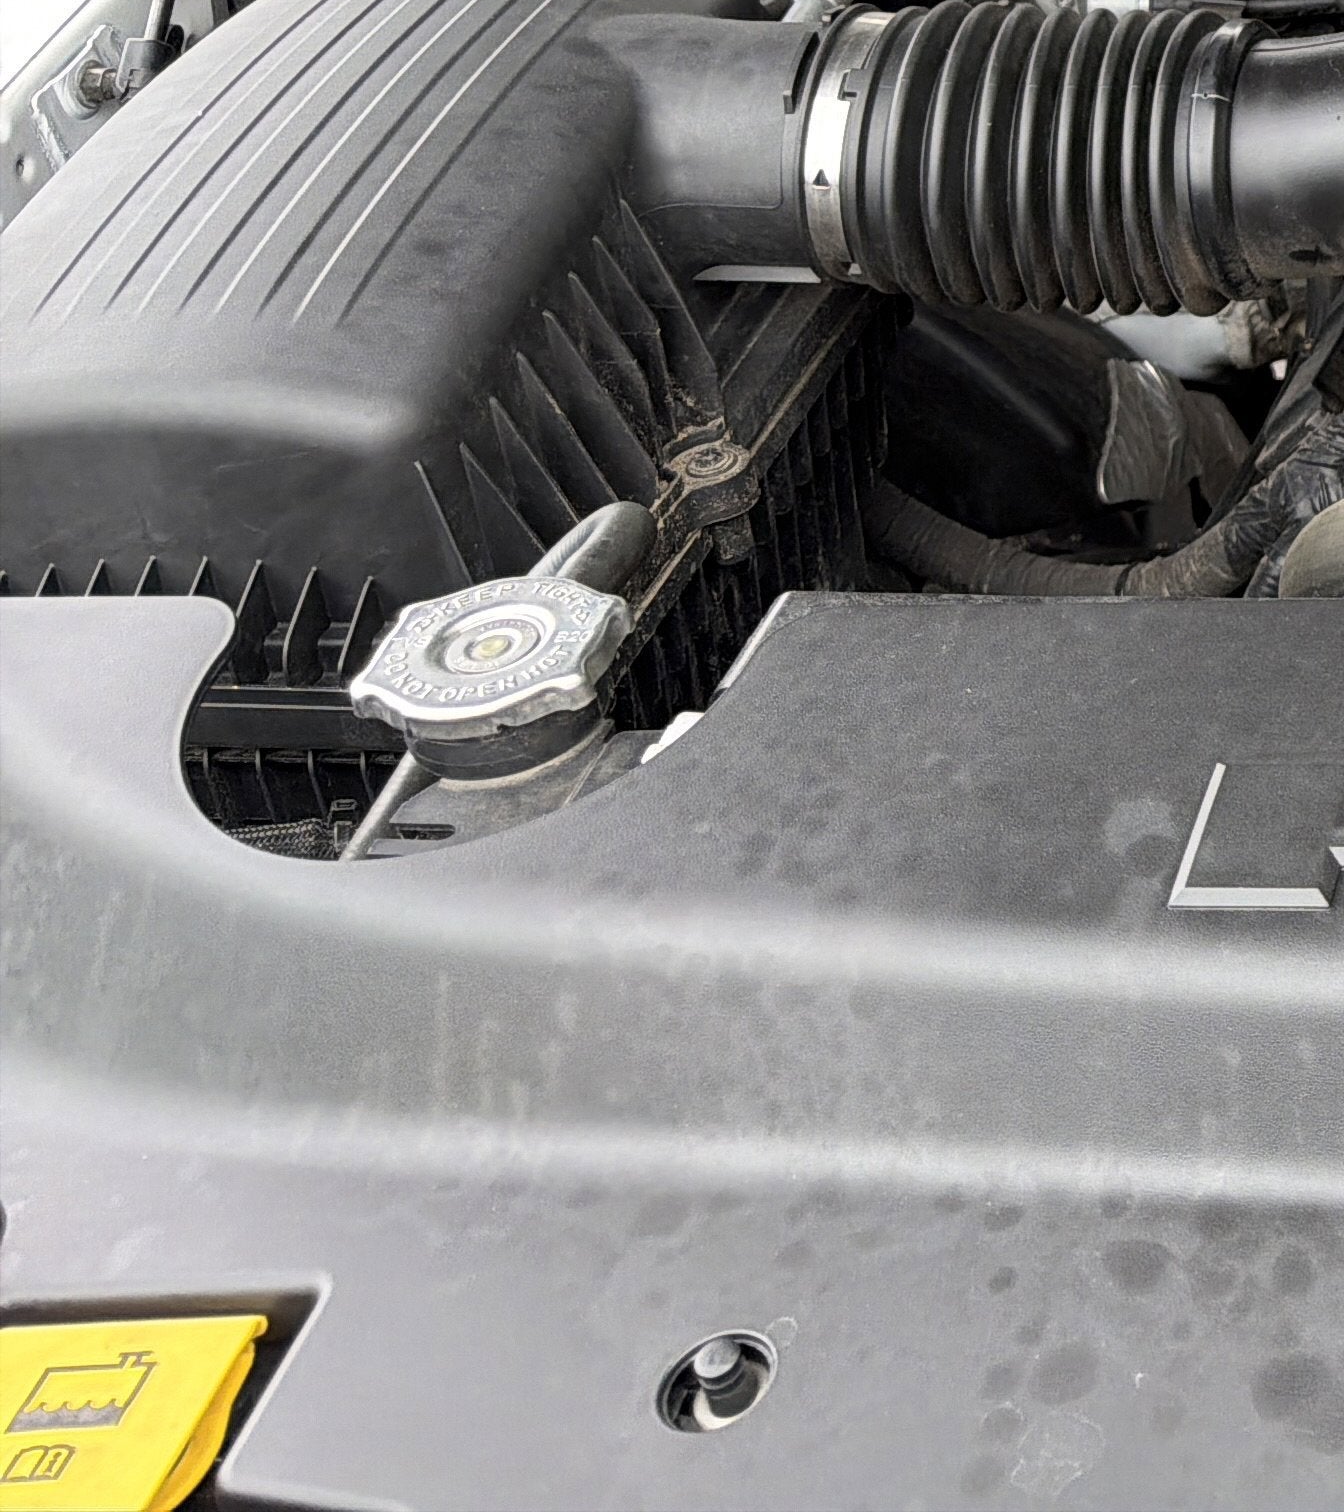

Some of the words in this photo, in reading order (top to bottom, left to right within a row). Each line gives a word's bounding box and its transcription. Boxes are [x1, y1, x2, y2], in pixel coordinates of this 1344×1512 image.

[433, 582, 516, 616] KEEP
[391, 671, 434, 700] NOT
[436, 678, 519, 703] OPEN
[522, 644, 571, 681] HOT
